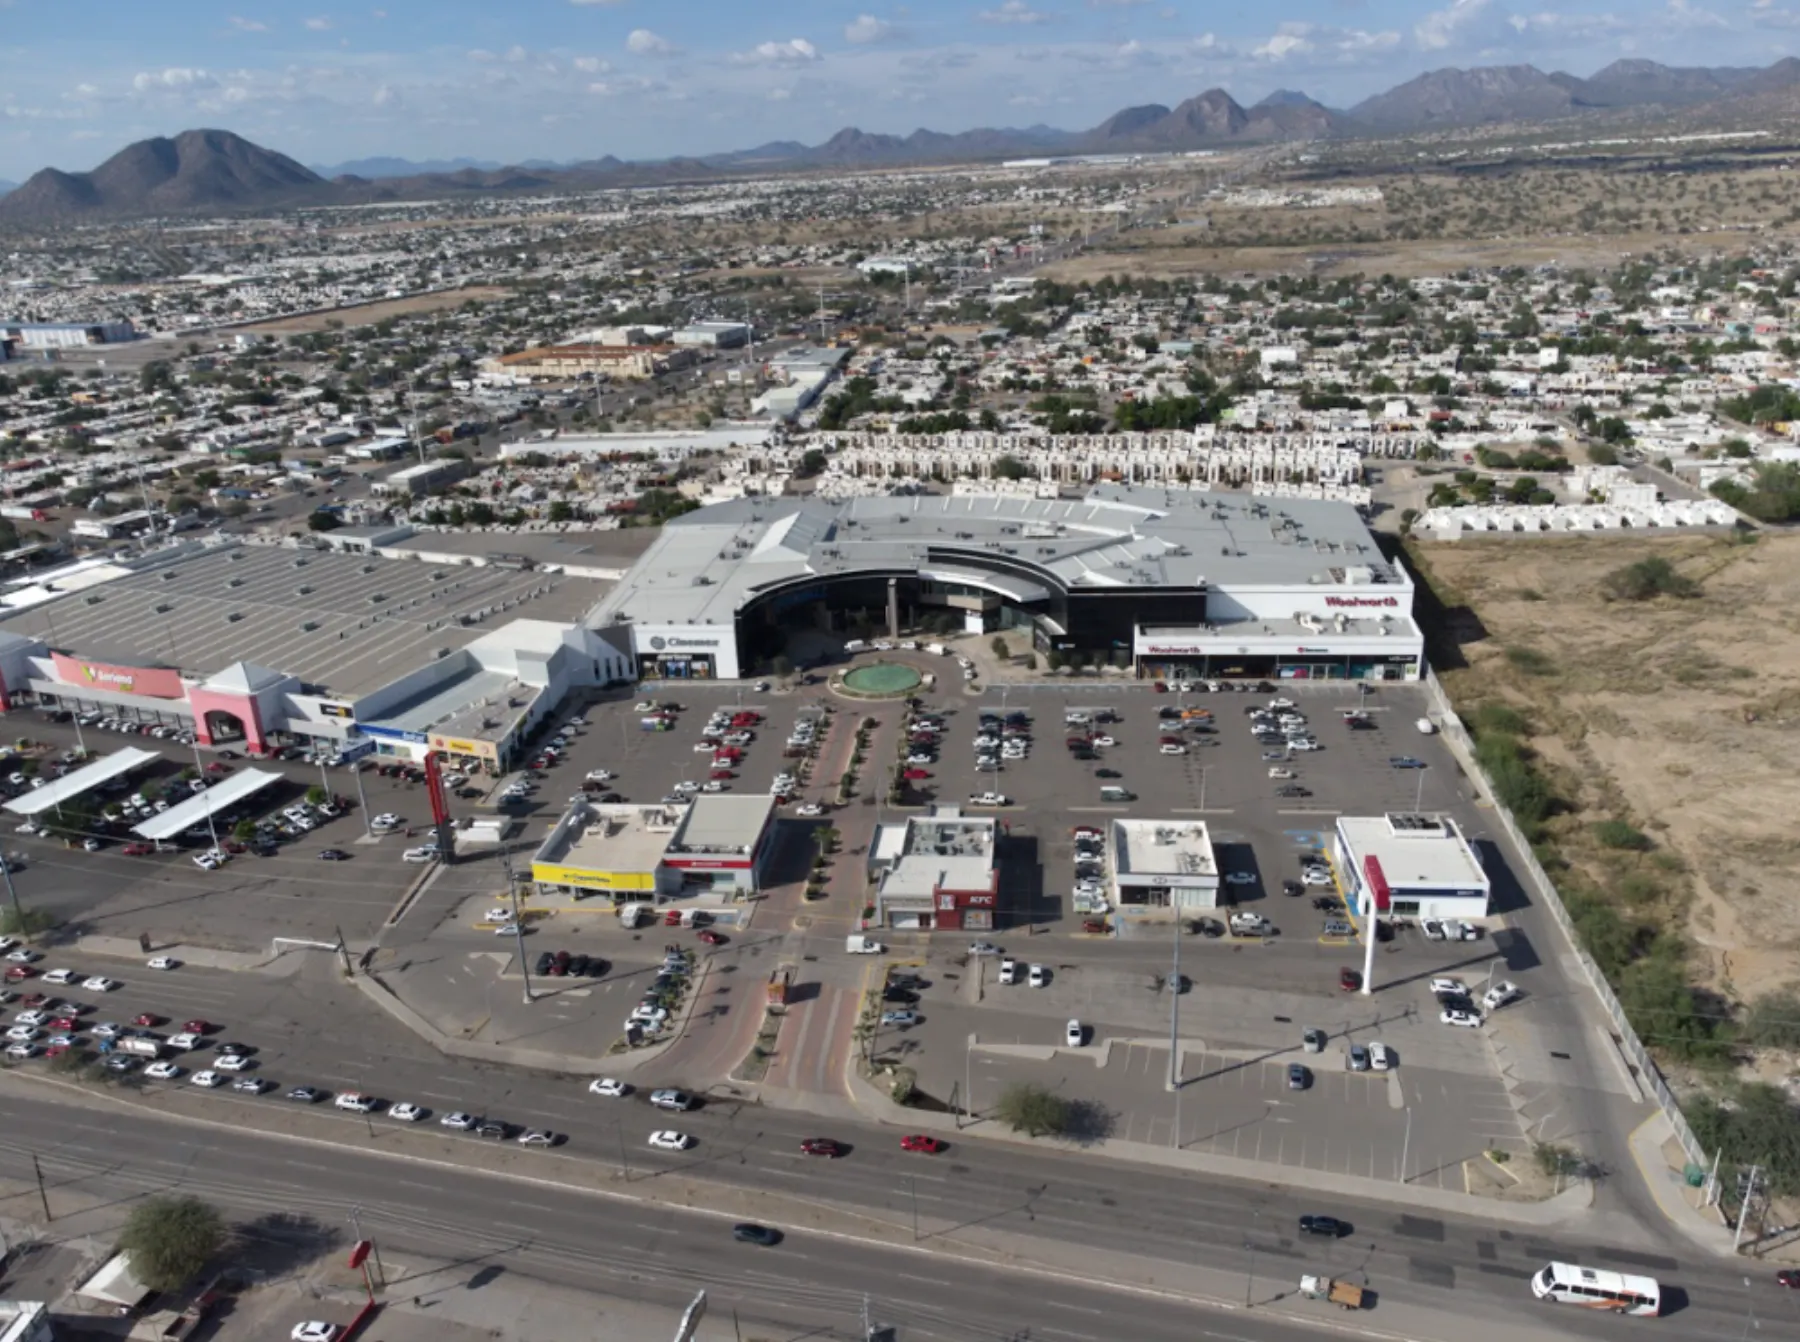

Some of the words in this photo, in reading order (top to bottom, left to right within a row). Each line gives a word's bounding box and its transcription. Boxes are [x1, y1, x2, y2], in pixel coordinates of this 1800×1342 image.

[1324, 596, 1398, 607] Woolworth
[1148, 646, 1201, 654] Woolworth
[969, 895, 993, 904] KFC
